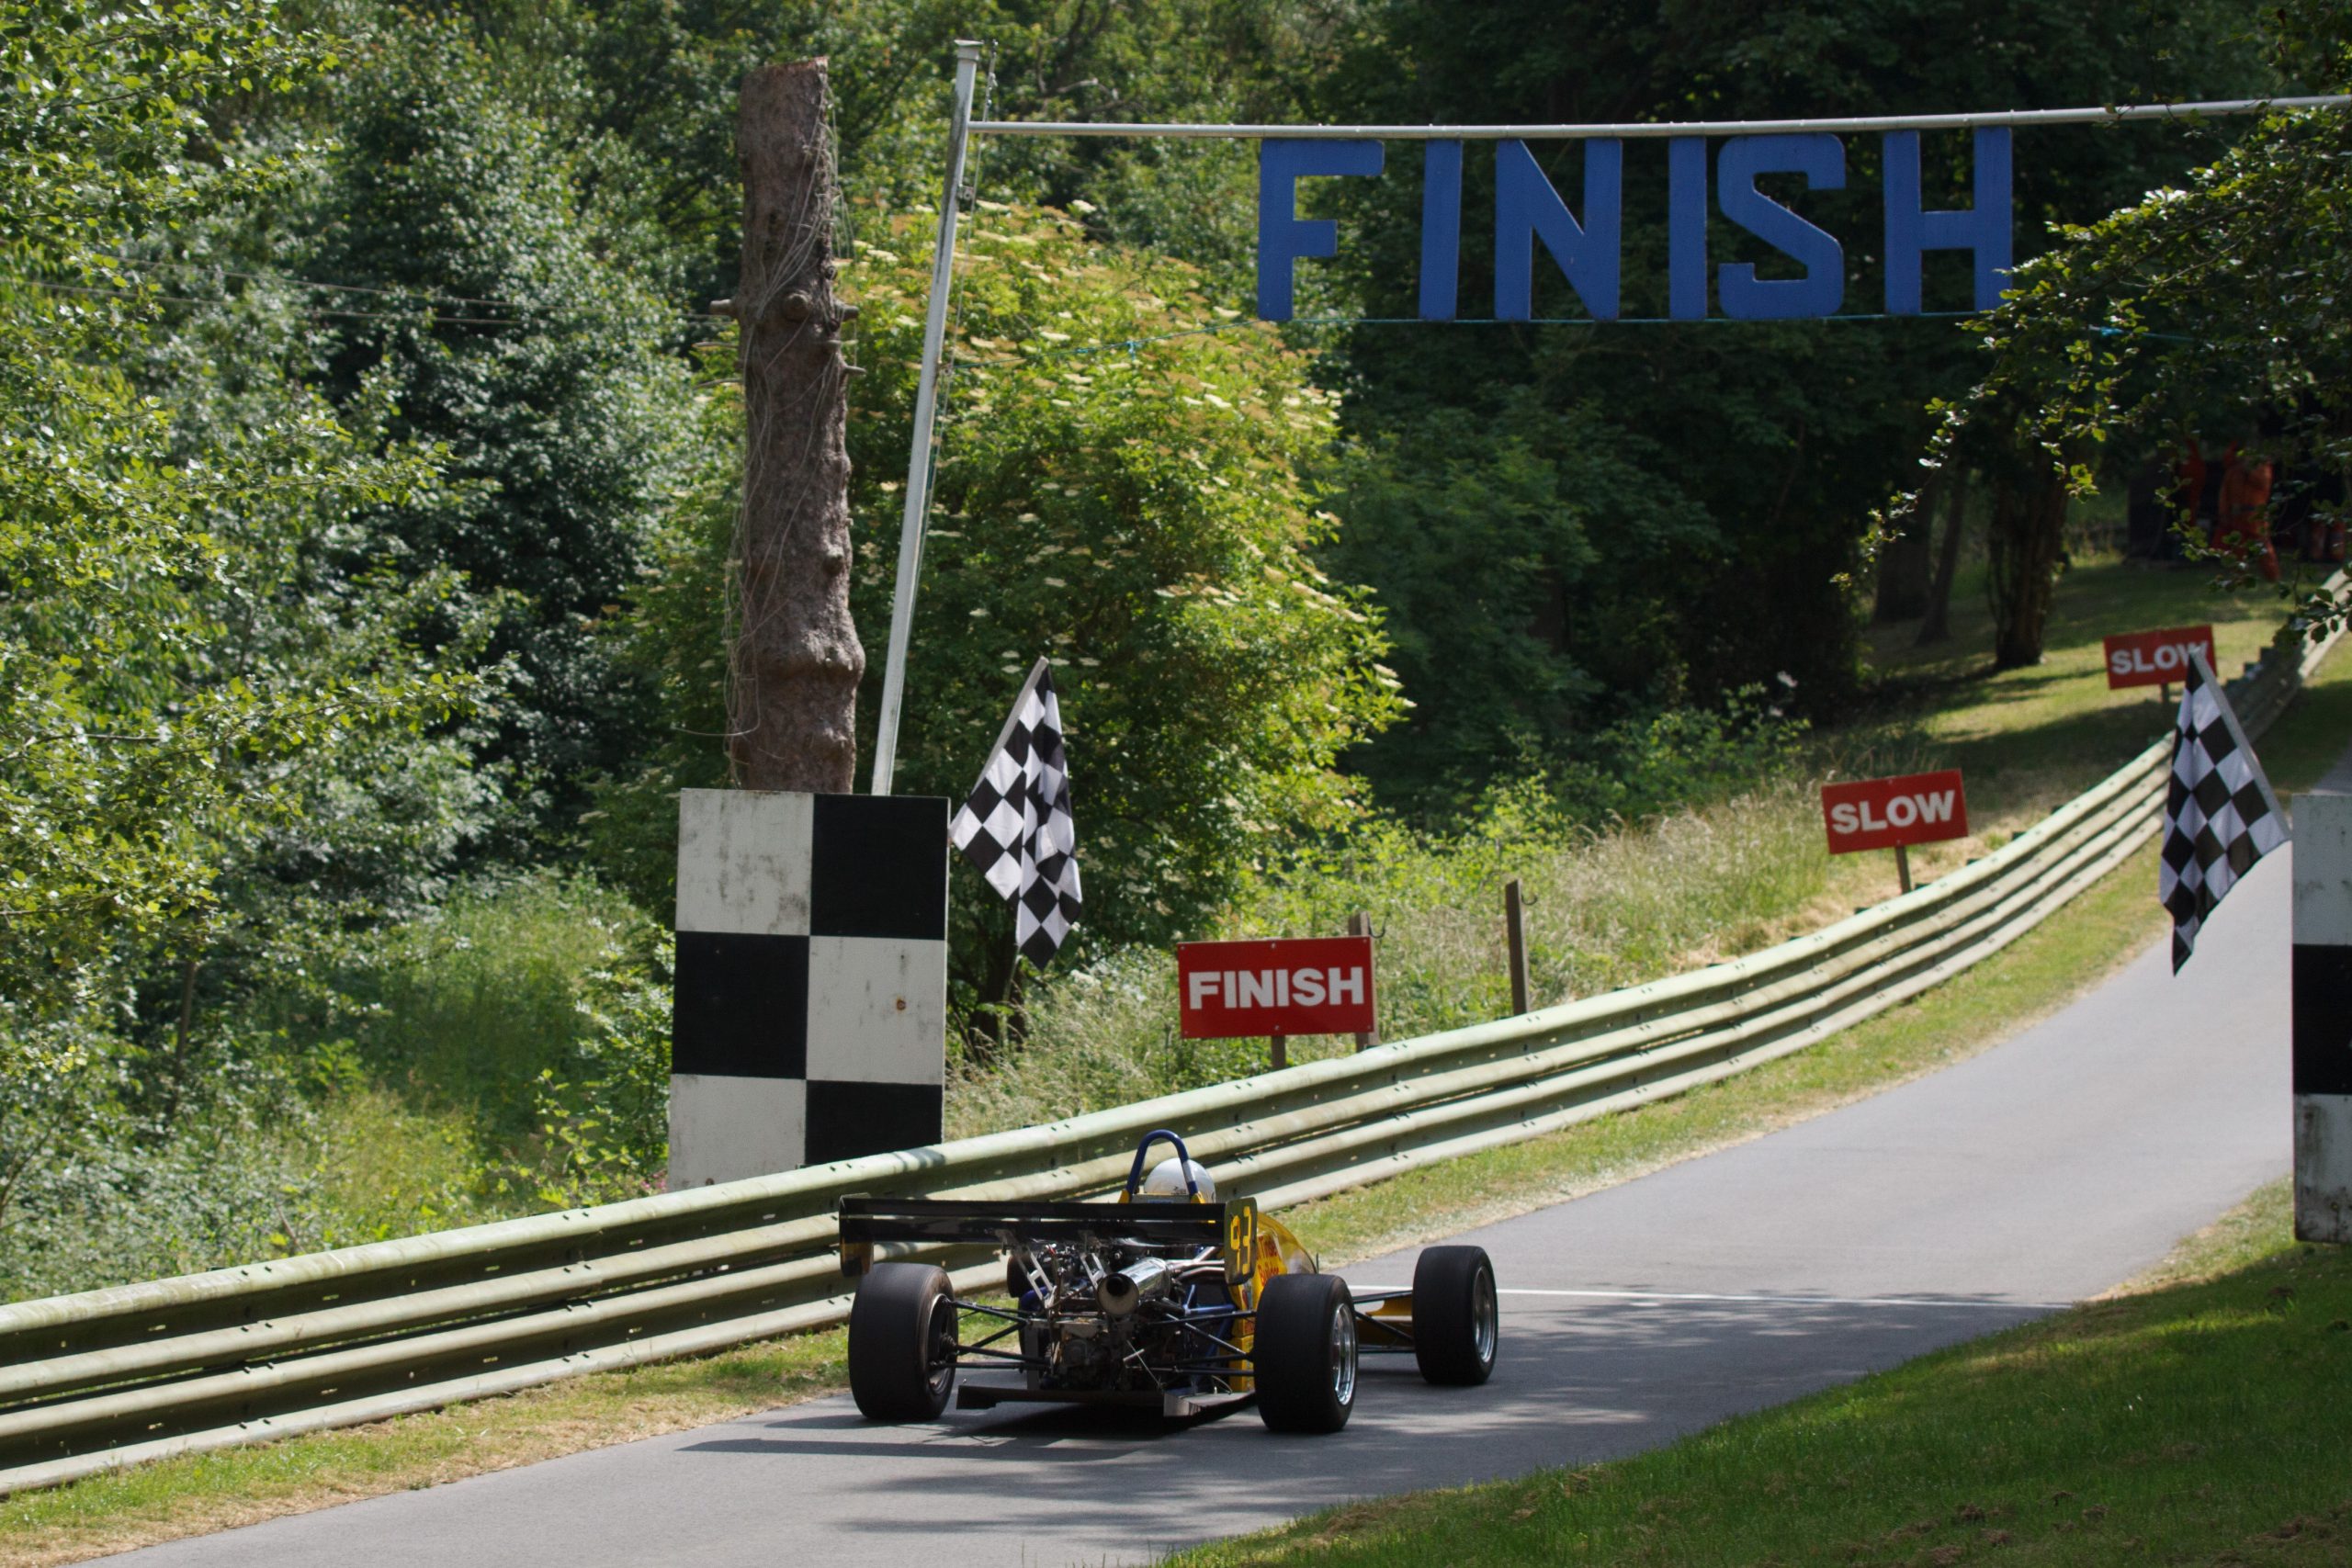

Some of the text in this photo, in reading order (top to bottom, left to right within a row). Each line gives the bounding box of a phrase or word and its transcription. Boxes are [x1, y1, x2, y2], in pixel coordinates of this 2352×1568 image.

[1258, 128, 2012, 321] FINISH
[1831, 790, 1955, 834] SLOW
[1189, 966, 1364, 1010] FINISH
[1230, 1205, 1251, 1275] 93
